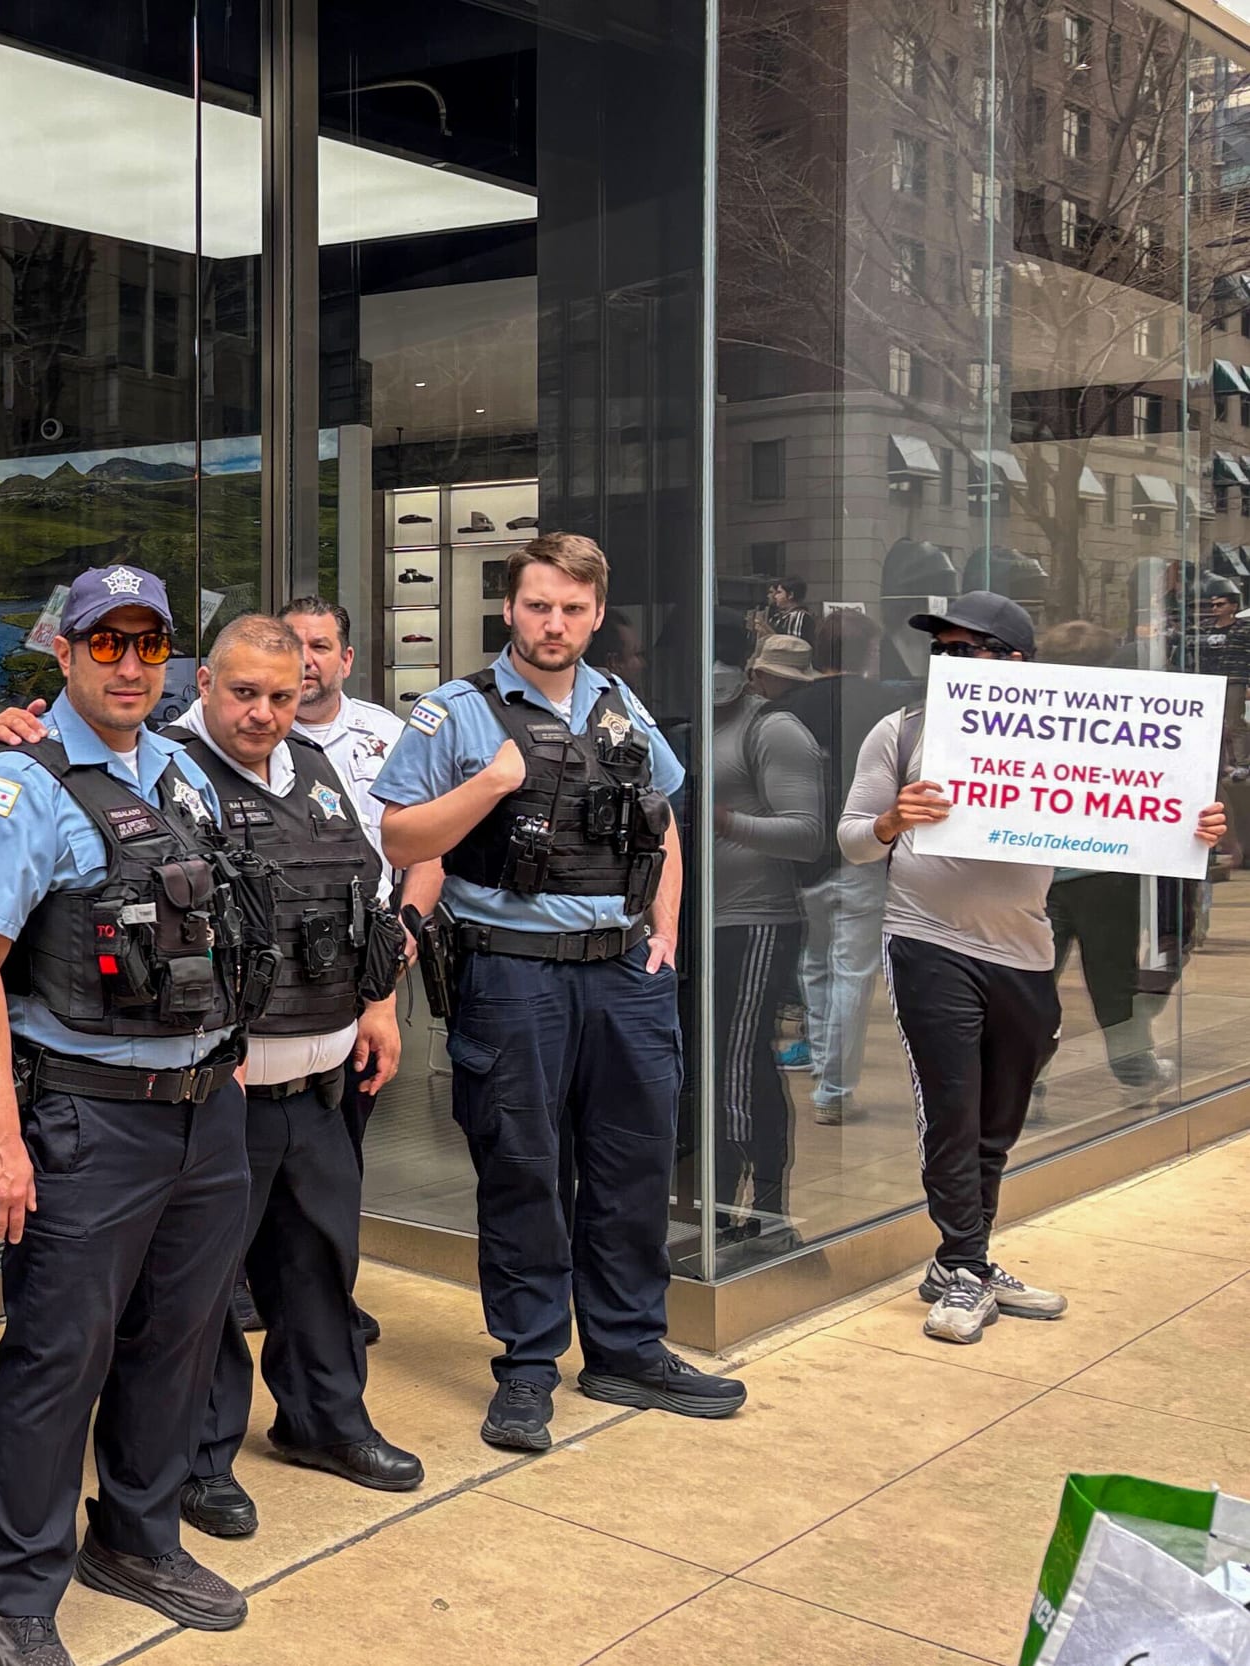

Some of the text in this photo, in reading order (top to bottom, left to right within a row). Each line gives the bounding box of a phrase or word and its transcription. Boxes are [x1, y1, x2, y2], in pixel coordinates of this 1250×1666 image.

[947, 681, 1204, 718] WE DON'T WANT YOUR
[960, 709, 1182, 750] SWASTICARS
[970, 756, 1164, 789] TAKE A ONE-WAY
[948, 780, 1183, 823] TRIP TO MARS
[987, 829, 1129, 856] #TeslaTakedown
